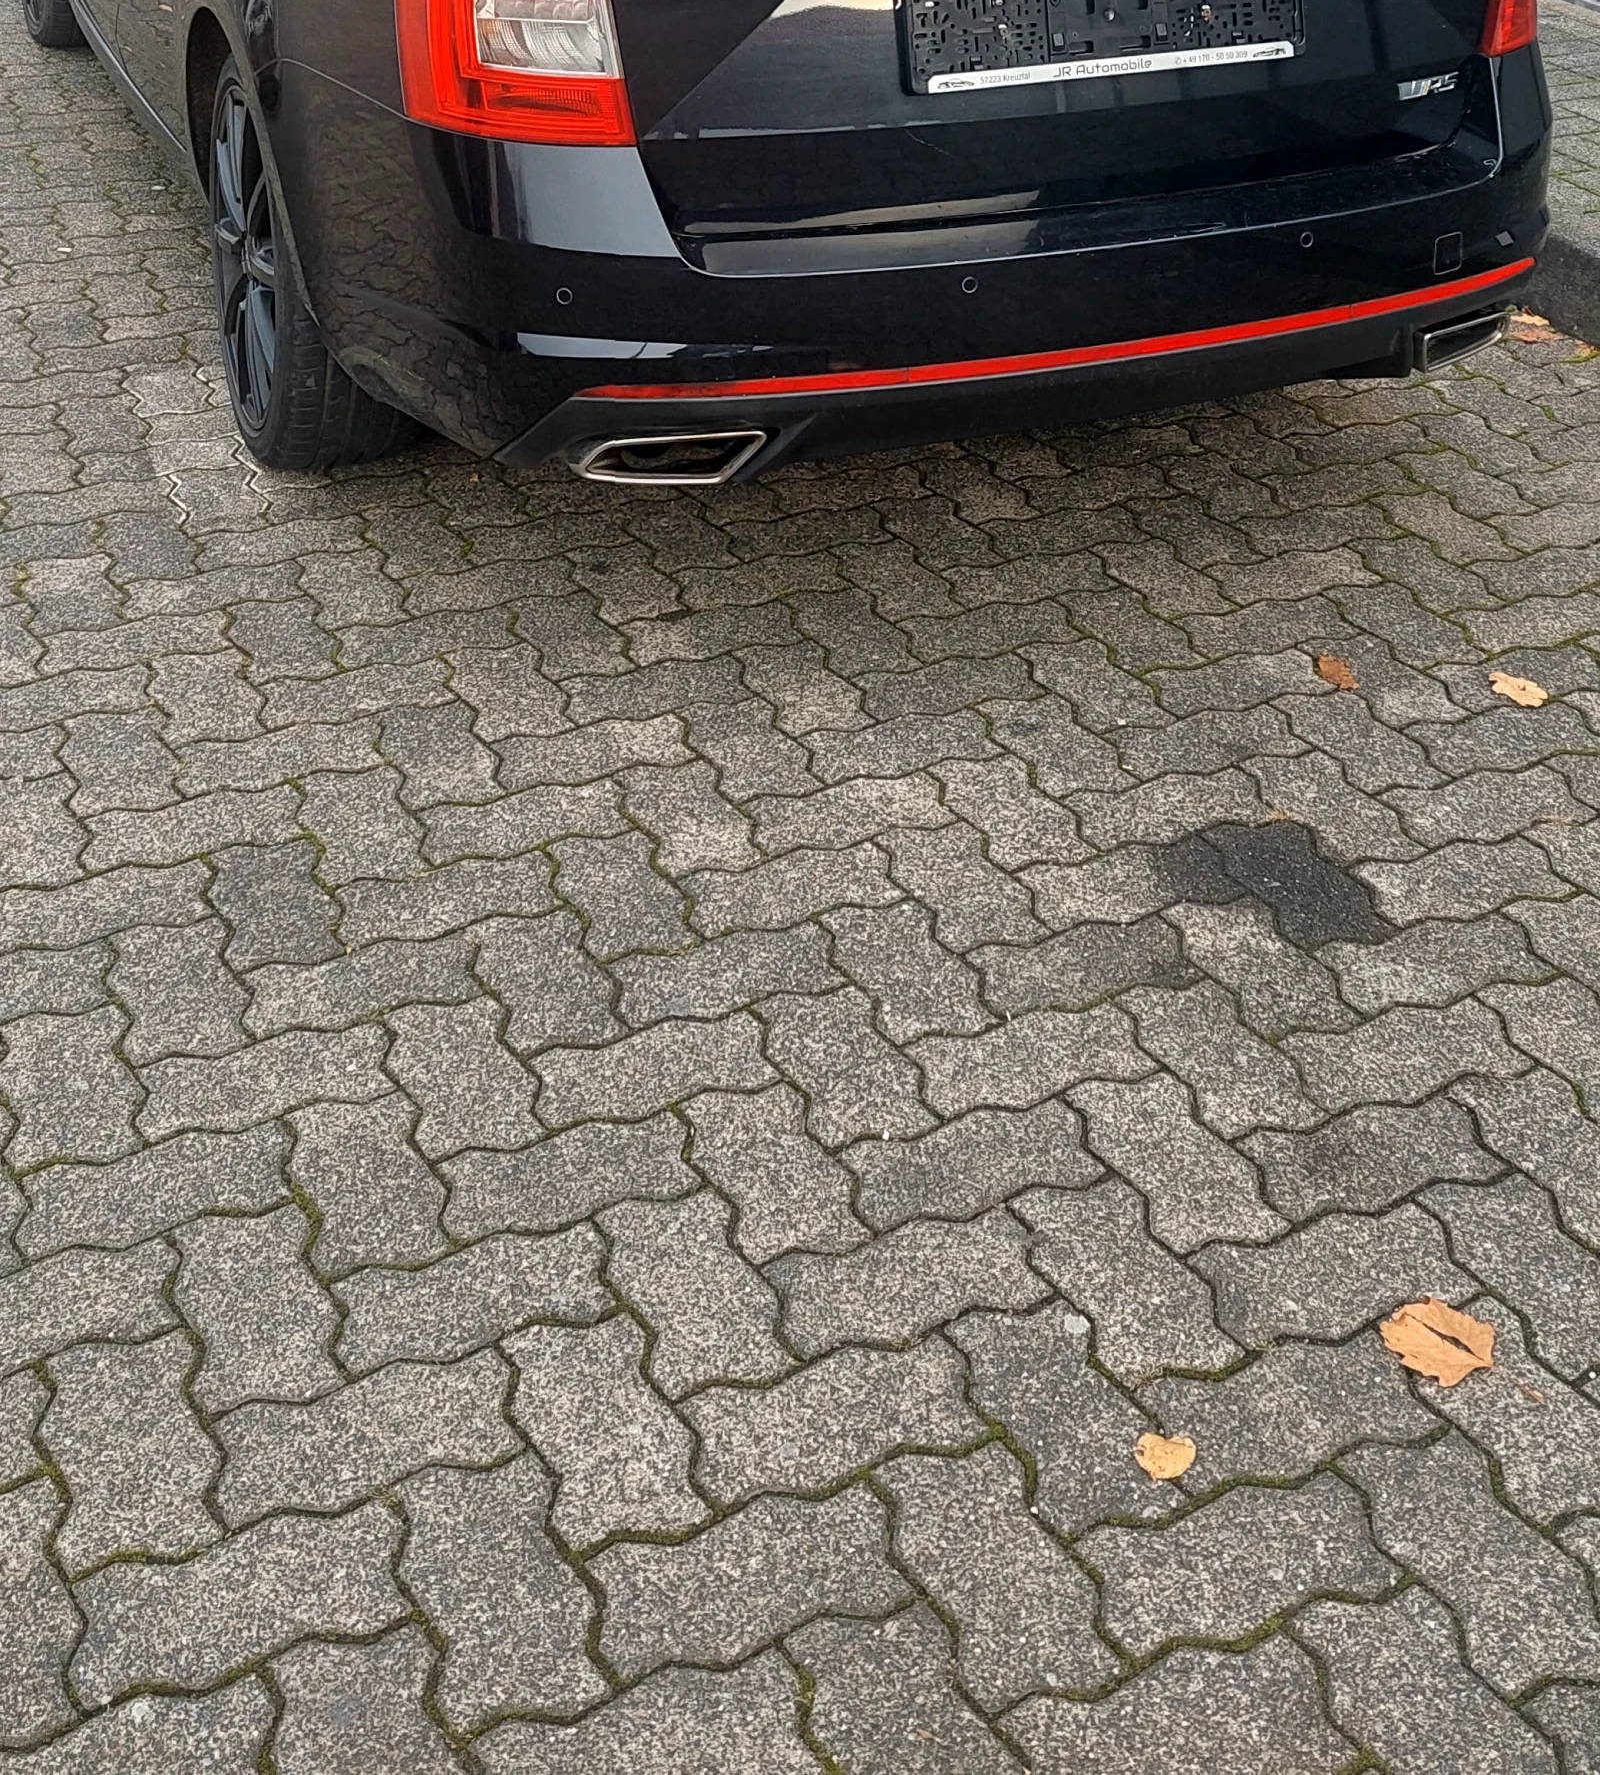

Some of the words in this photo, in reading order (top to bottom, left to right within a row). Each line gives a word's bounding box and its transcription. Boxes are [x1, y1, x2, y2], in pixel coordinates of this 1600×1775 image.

[980, 75, 1001, 85] 57223
[1003, 72, 1031, 82] Kreuztal
[1053, 66, 1072, 78] JR
[1076, 58, 1152, 76] Automobile
